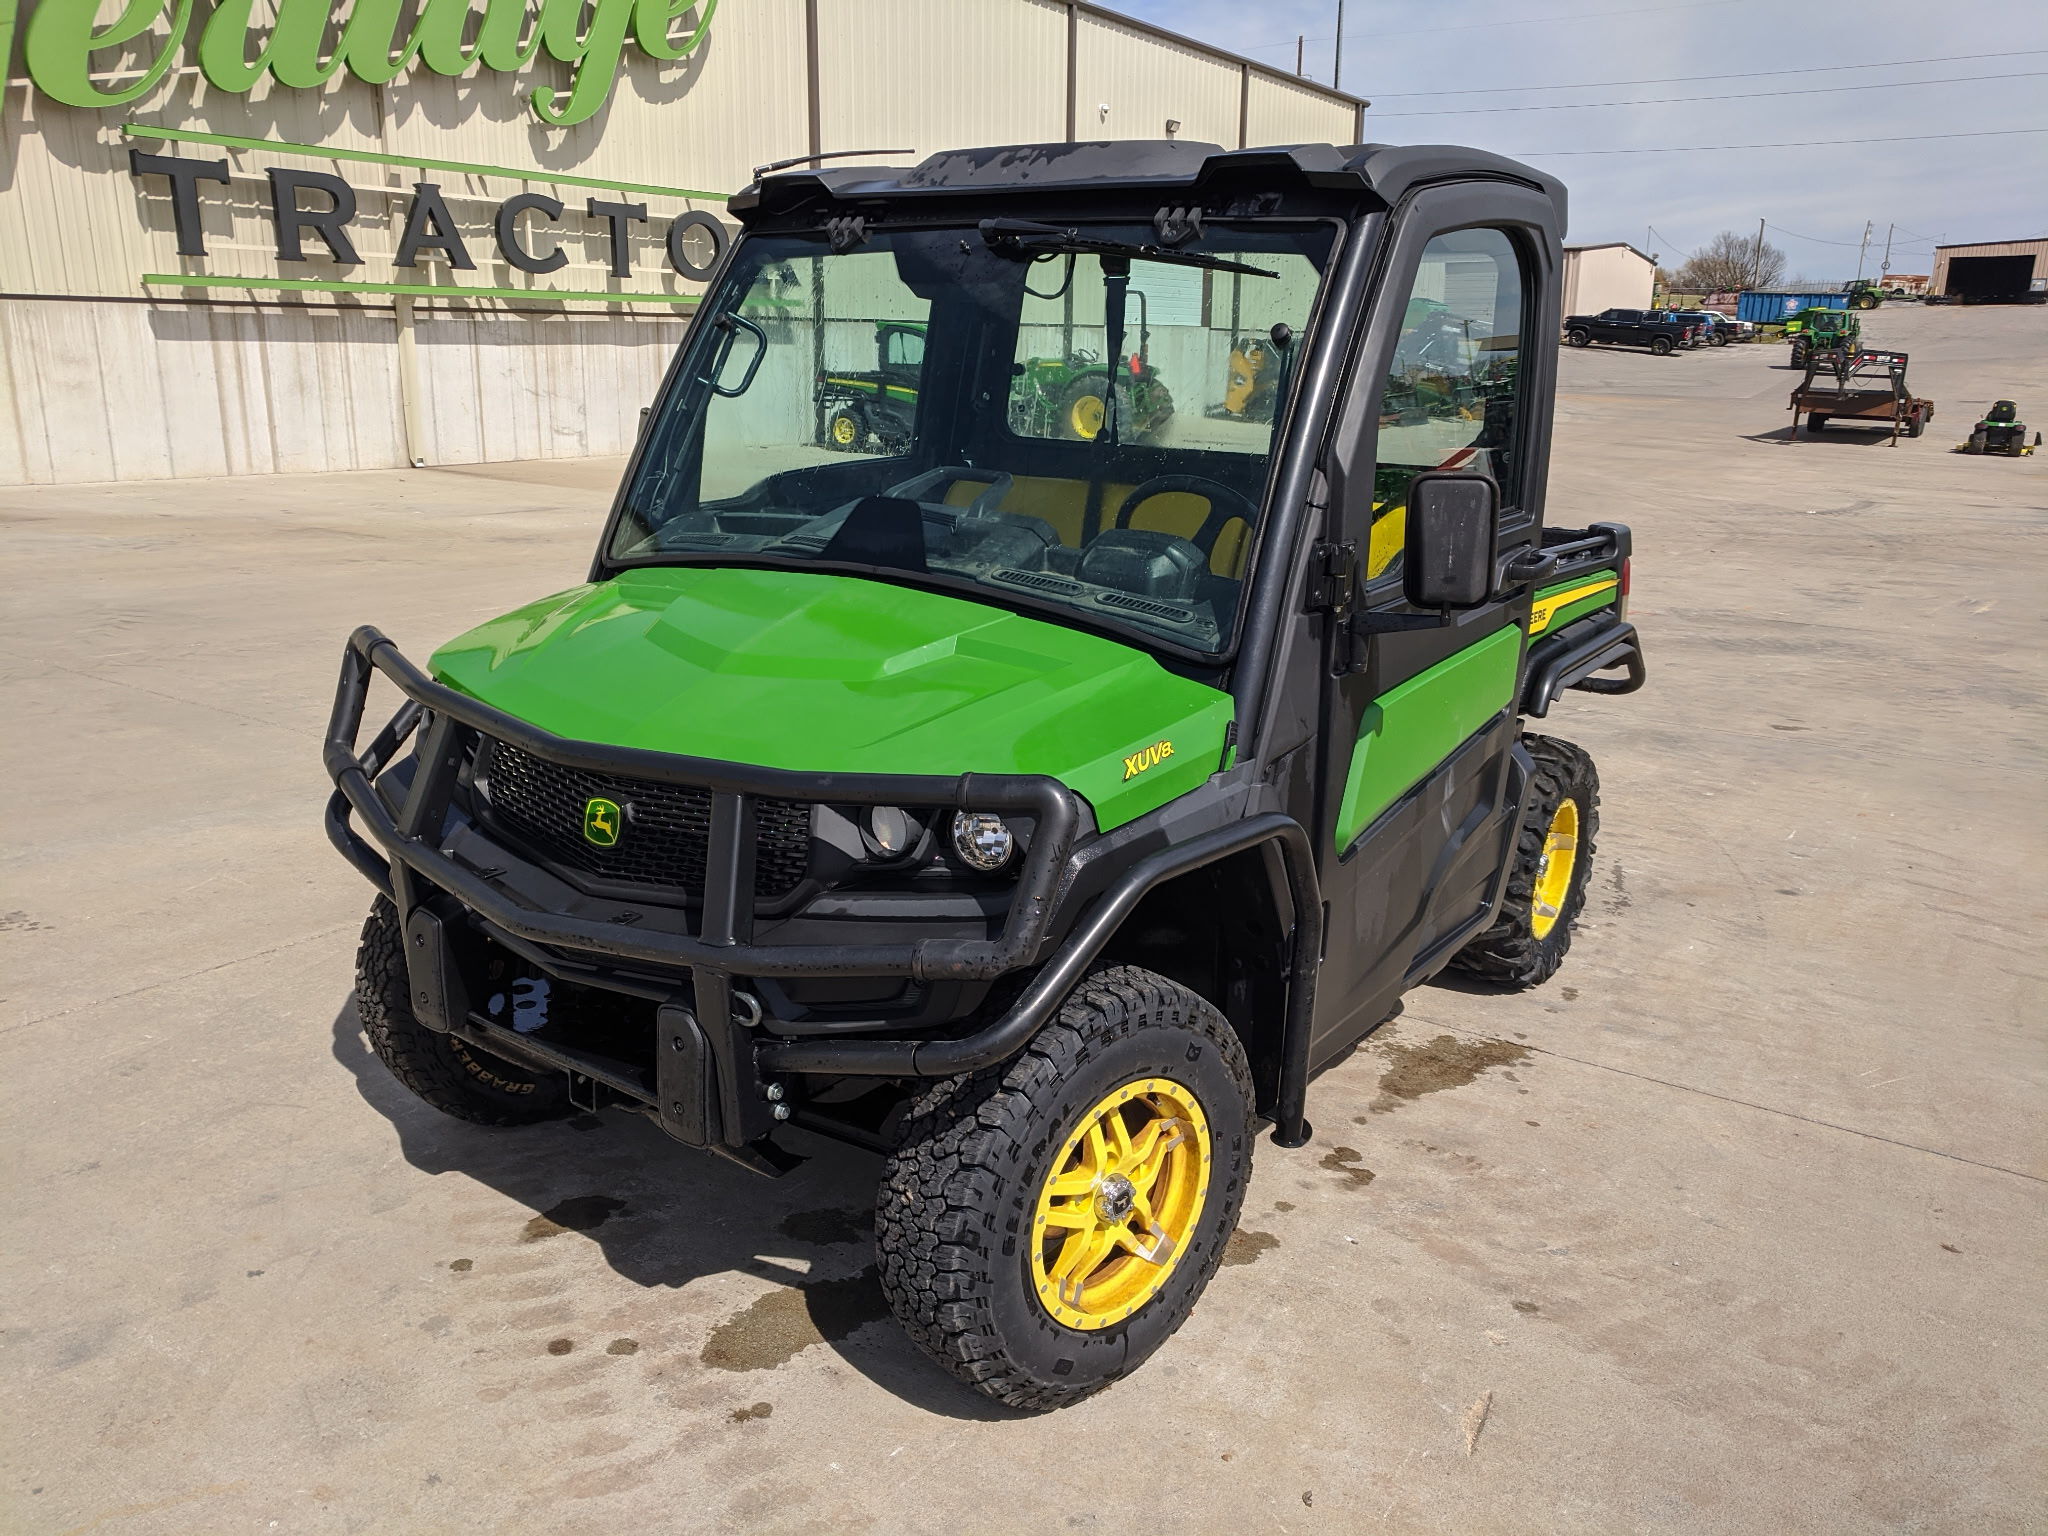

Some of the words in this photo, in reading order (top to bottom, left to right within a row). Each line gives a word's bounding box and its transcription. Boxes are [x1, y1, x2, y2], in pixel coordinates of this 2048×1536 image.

[129, 148, 729, 282] TRACTO
[1529, 608, 1547, 624] EERE
[449, 1036, 536, 1095] GRABBER
